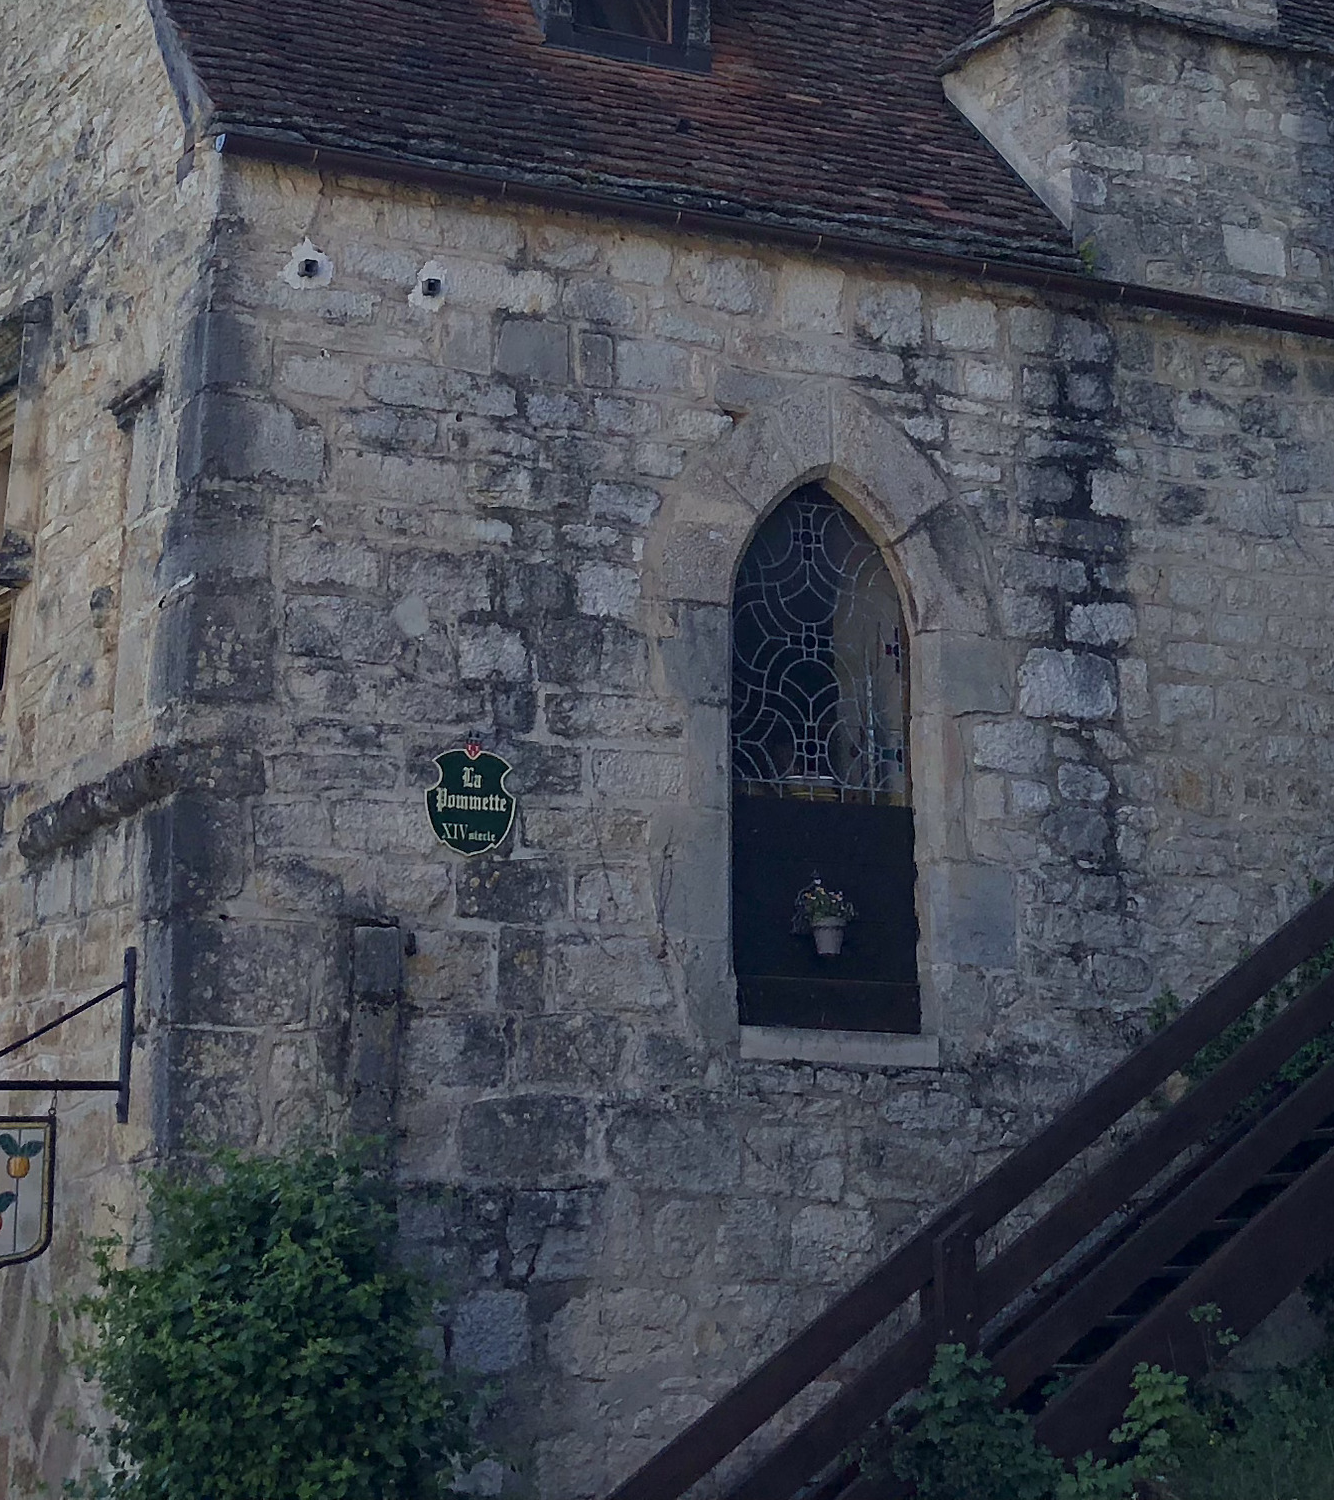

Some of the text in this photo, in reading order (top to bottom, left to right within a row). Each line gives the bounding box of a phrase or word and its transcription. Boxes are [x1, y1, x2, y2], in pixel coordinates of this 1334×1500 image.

[462, 766, 482, 788] La
[436, 787, 507, 812] Pommette
[441, 822, 468, 840] XIV
